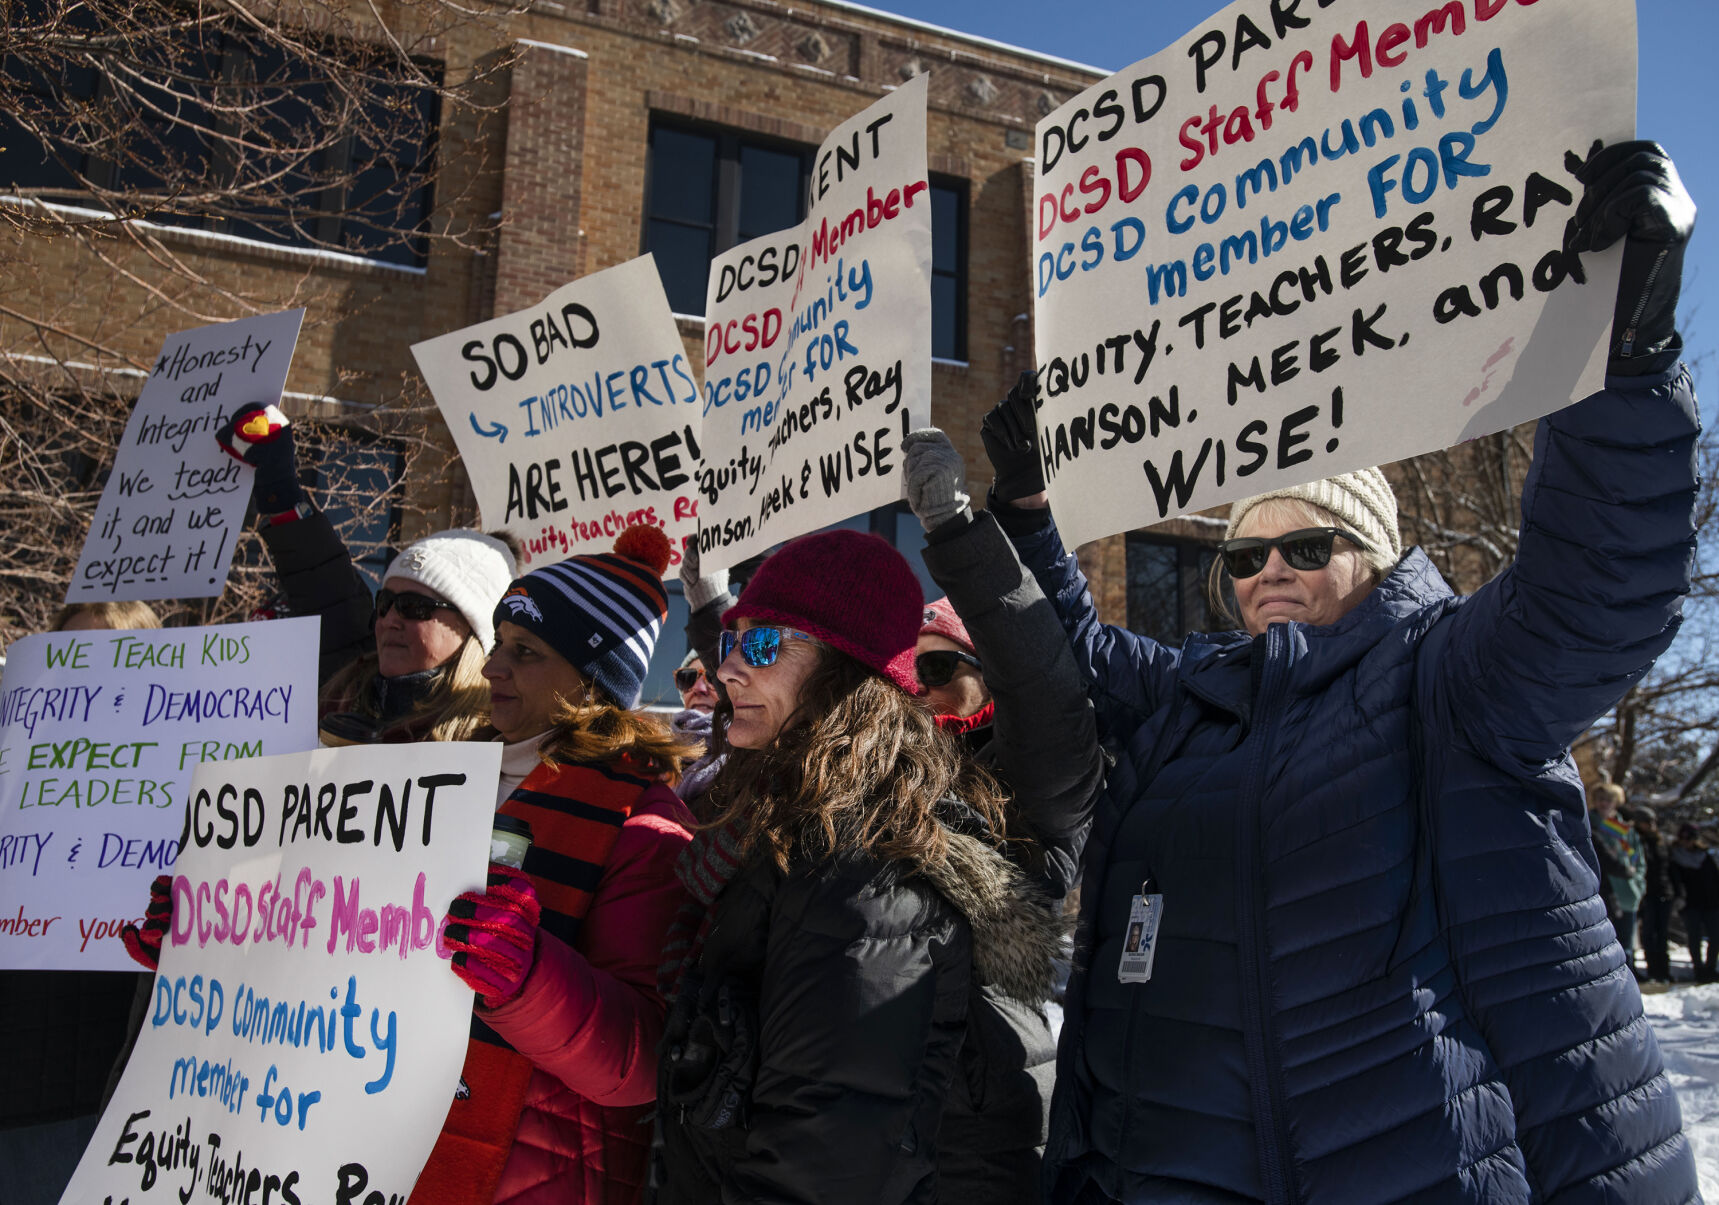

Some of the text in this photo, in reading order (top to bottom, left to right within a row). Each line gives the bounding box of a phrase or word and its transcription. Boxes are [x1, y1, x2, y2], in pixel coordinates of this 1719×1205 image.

[1042, 0, 1337, 176] DCSD PAR
[1039, 147, 1152, 242] DCSD
[1179, 50, 1313, 172] Staff
[1039, 47, 1509, 298] DCSD Community
[1145, 131, 1491, 306] member FOR
[706, 180, 928, 368] DCSD Member
[715, 243, 800, 303] DCSD
[1432, 216, 1587, 324] and
[461, 302, 600, 391] SO BAD
[180, 373, 223, 403] and
[518, 354, 697, 437] INTROVERTS
[703, 361, 771, 418] DCSD
[844, 359, 902, 414] Ray
[119, 461, 241, 497] We teach
[504, 424, 702, 524] ARE HERE!
[1143, 385, 1345, 518] WISE!
[100, 506, 122, 554] it,
[132, 508, 175, 537] and
[84, 545, 175, 594] expect
[45, 632, 251, 670] WE TEACH KIDS
[141, 684, 293, 727] DEMOCRACY
[27, 737, 159, 772] EXPECT
[179, 739, 263, 771] FROM
[19, 778, 177, 810] LEADERS
[278, 773, 467, 852] PARENT
[170, 873, 253, 949] DCSD
[152, 974, 225, 1037] DCSD
[170, 1055, 322, 1132] member for
